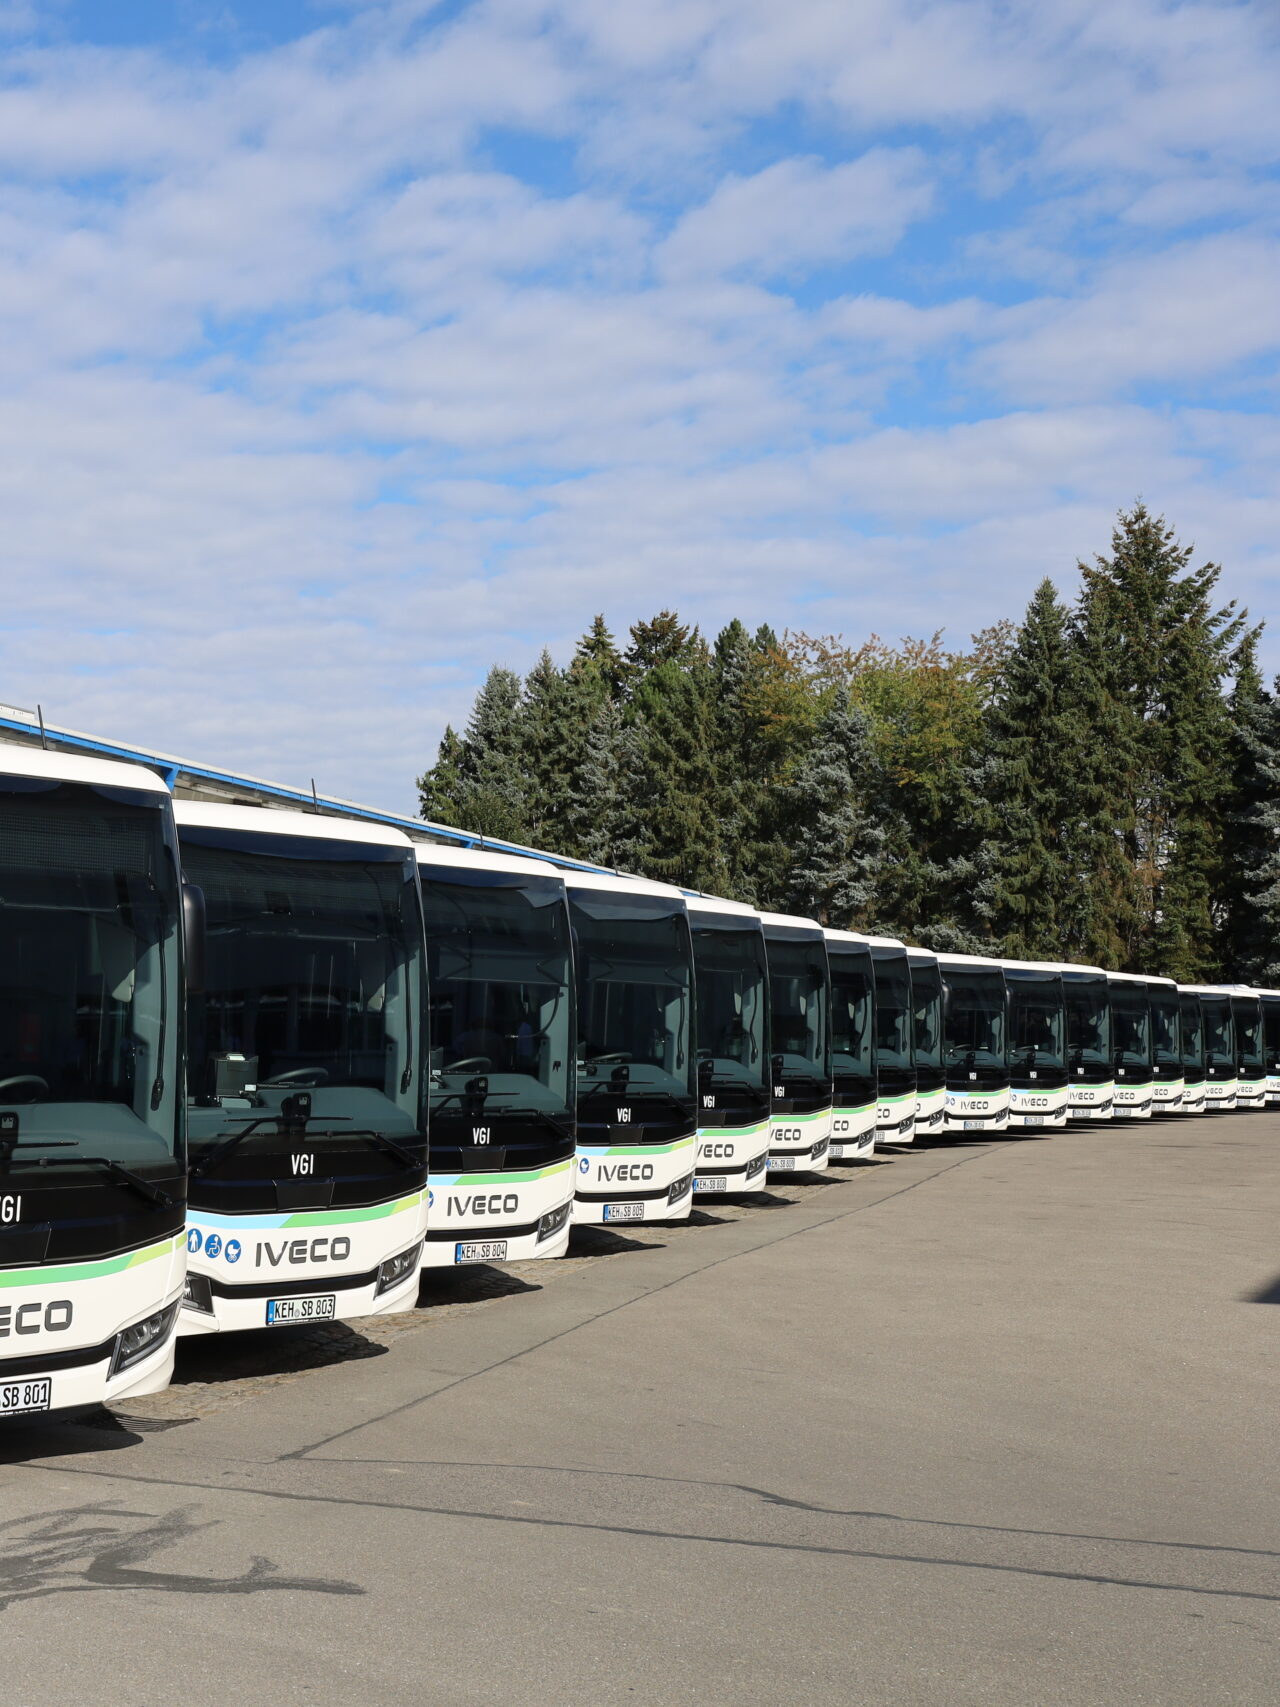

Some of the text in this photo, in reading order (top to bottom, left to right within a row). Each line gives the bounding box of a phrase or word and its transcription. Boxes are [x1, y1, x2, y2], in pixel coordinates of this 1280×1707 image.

[774, 1086, 785, 1097] VGI
[1070, 1092, 1095, 1101] IVECO
[1113, 1092, 1136, 1100] VECO
[1206, 1087, 1223, 1095] VECO
[703, 1095, 715, 1108] VGI
[960, 1101, 989, 1110] IVECO
[1021, 1098, 1048, 1107] IVECO
[617, 1108, 631, 1122] VGI
[473, 1127, 490, 1145] VGI
[770, 1128, 802, 1141] ECO
[698, 1144, 734, 1158] ECO
[291, 1154, 314, 1175] VGI
[598, 1164, 654, 1182] IVECO
[447, 1194, 518, 1216] IVECO
[608, 1206, 643, 1218] KEH SB 805
[255, 1236, 350, 1267] IVECO
[461, 1244, 505, 1259] KEH SB 804
[274, 1298, 333, 1319] KEH SB 803
[2, 1386, 20, 1408] SB
[24, 1382, 48, 1405] 801
